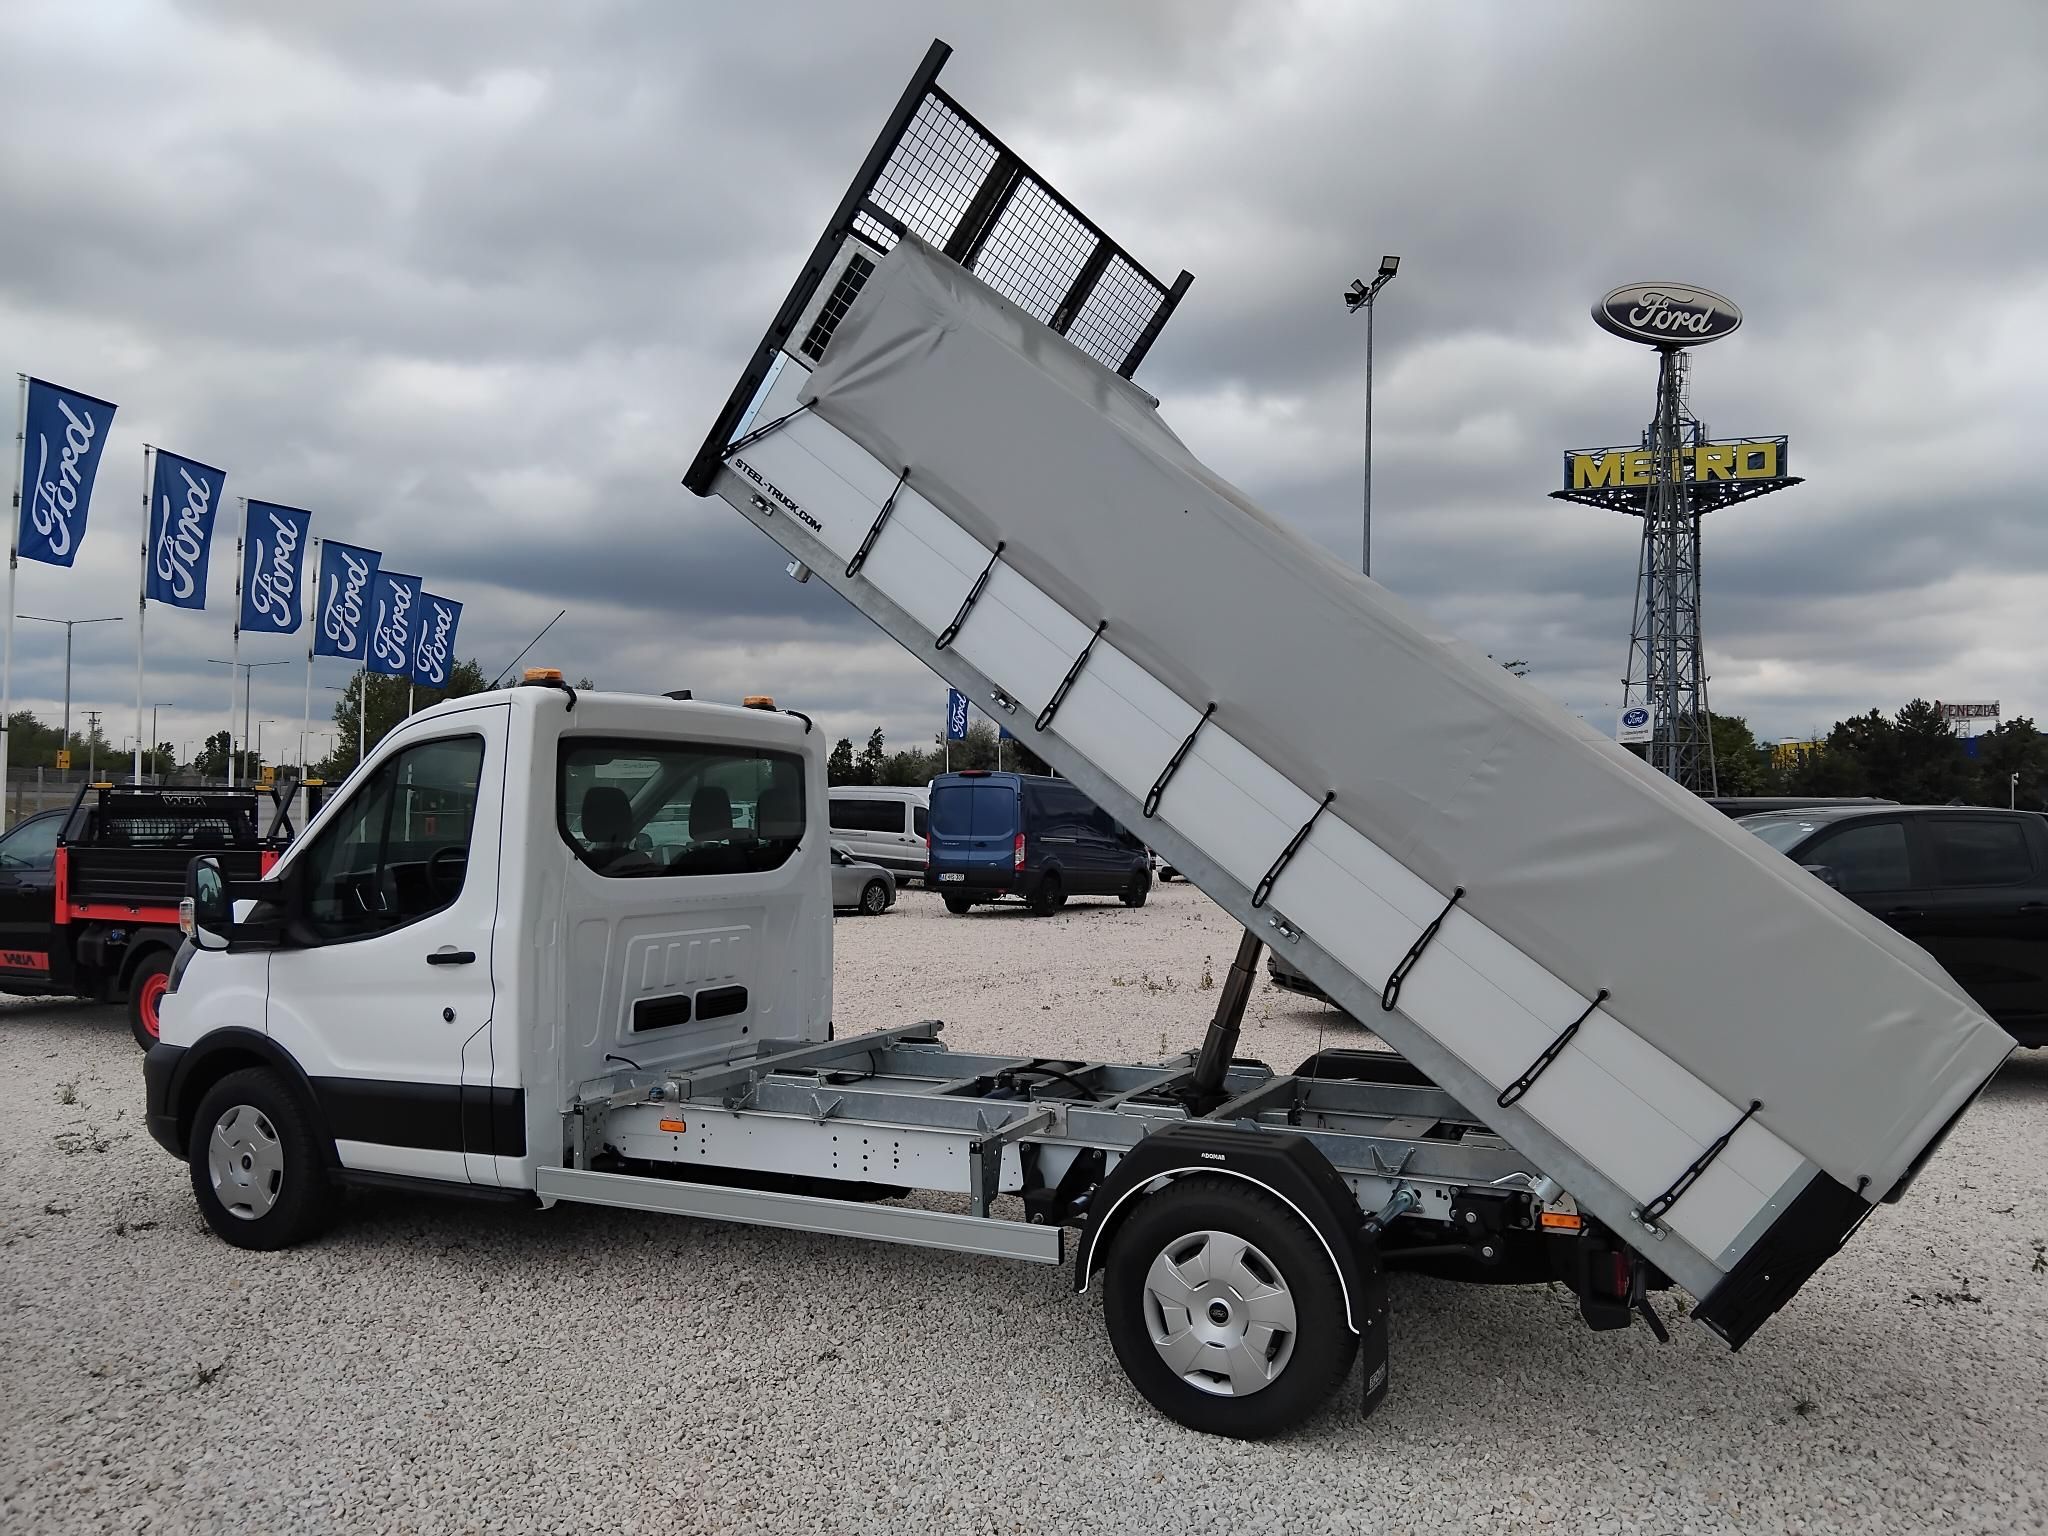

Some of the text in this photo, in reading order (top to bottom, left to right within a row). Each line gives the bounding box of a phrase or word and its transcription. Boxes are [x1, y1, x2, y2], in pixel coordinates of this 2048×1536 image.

[1629, 292, 1715, 333] Ford
[32, 399, 95, 556] Ford
[735, 458, 822, 533] STEEL-TRUCK.COM
[157, 467, 211, 599] Ford
[251, 512, 298, 627] Ford
[324, 551, 369, 652] Ford
[373, 579, 412, 669] Ford
[416, 602, 453, 683] Ford
[952, 692, 967, 738] Ford
[1936, 700, 1999, 718] VENEZIA
